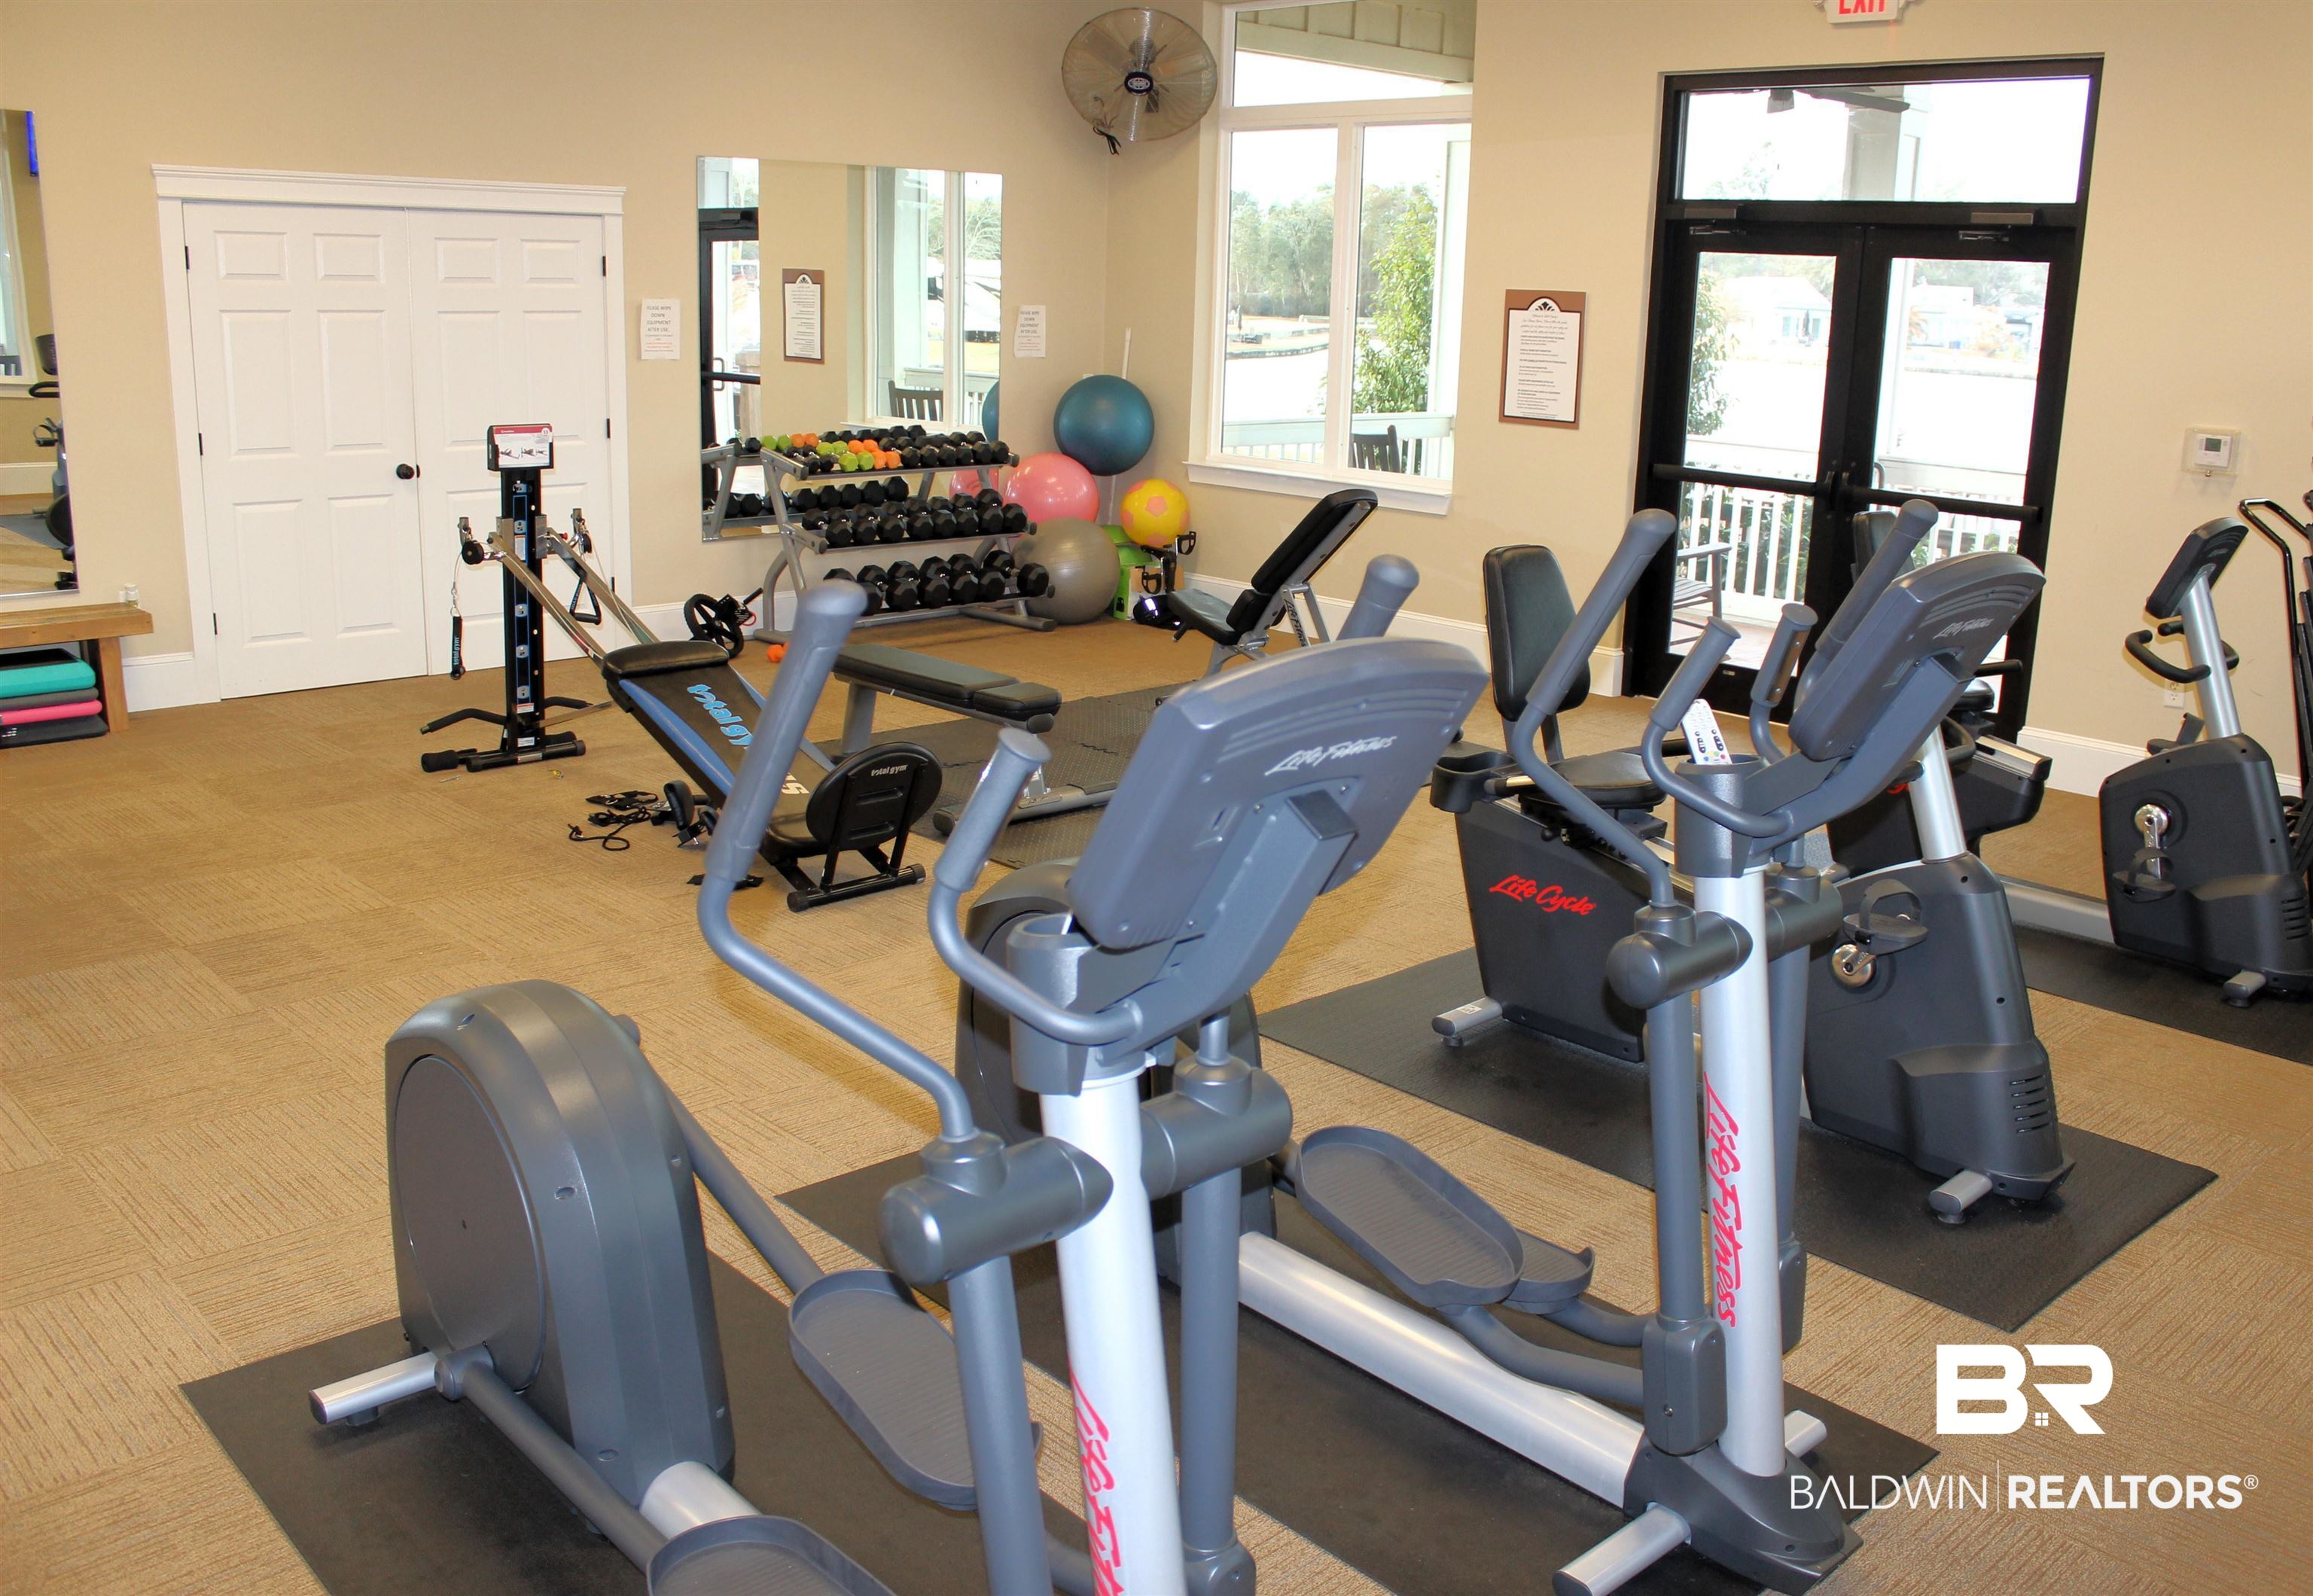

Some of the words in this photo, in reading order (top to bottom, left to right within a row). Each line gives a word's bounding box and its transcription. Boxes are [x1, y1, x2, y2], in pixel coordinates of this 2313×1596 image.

[686, 684, 743, 725] total
[870, 766, 891, 777] total
[1264, 745, 1324, 776] Life
[1312, 736, 1398, 767] Fitness
[1489, 874, 1538, 902] Life
[1535, 885, 1597, 915] Cycle
[1703, 1071, 1741, 1176] Life
[1707, 1162, 1744, 1328] Fitness
